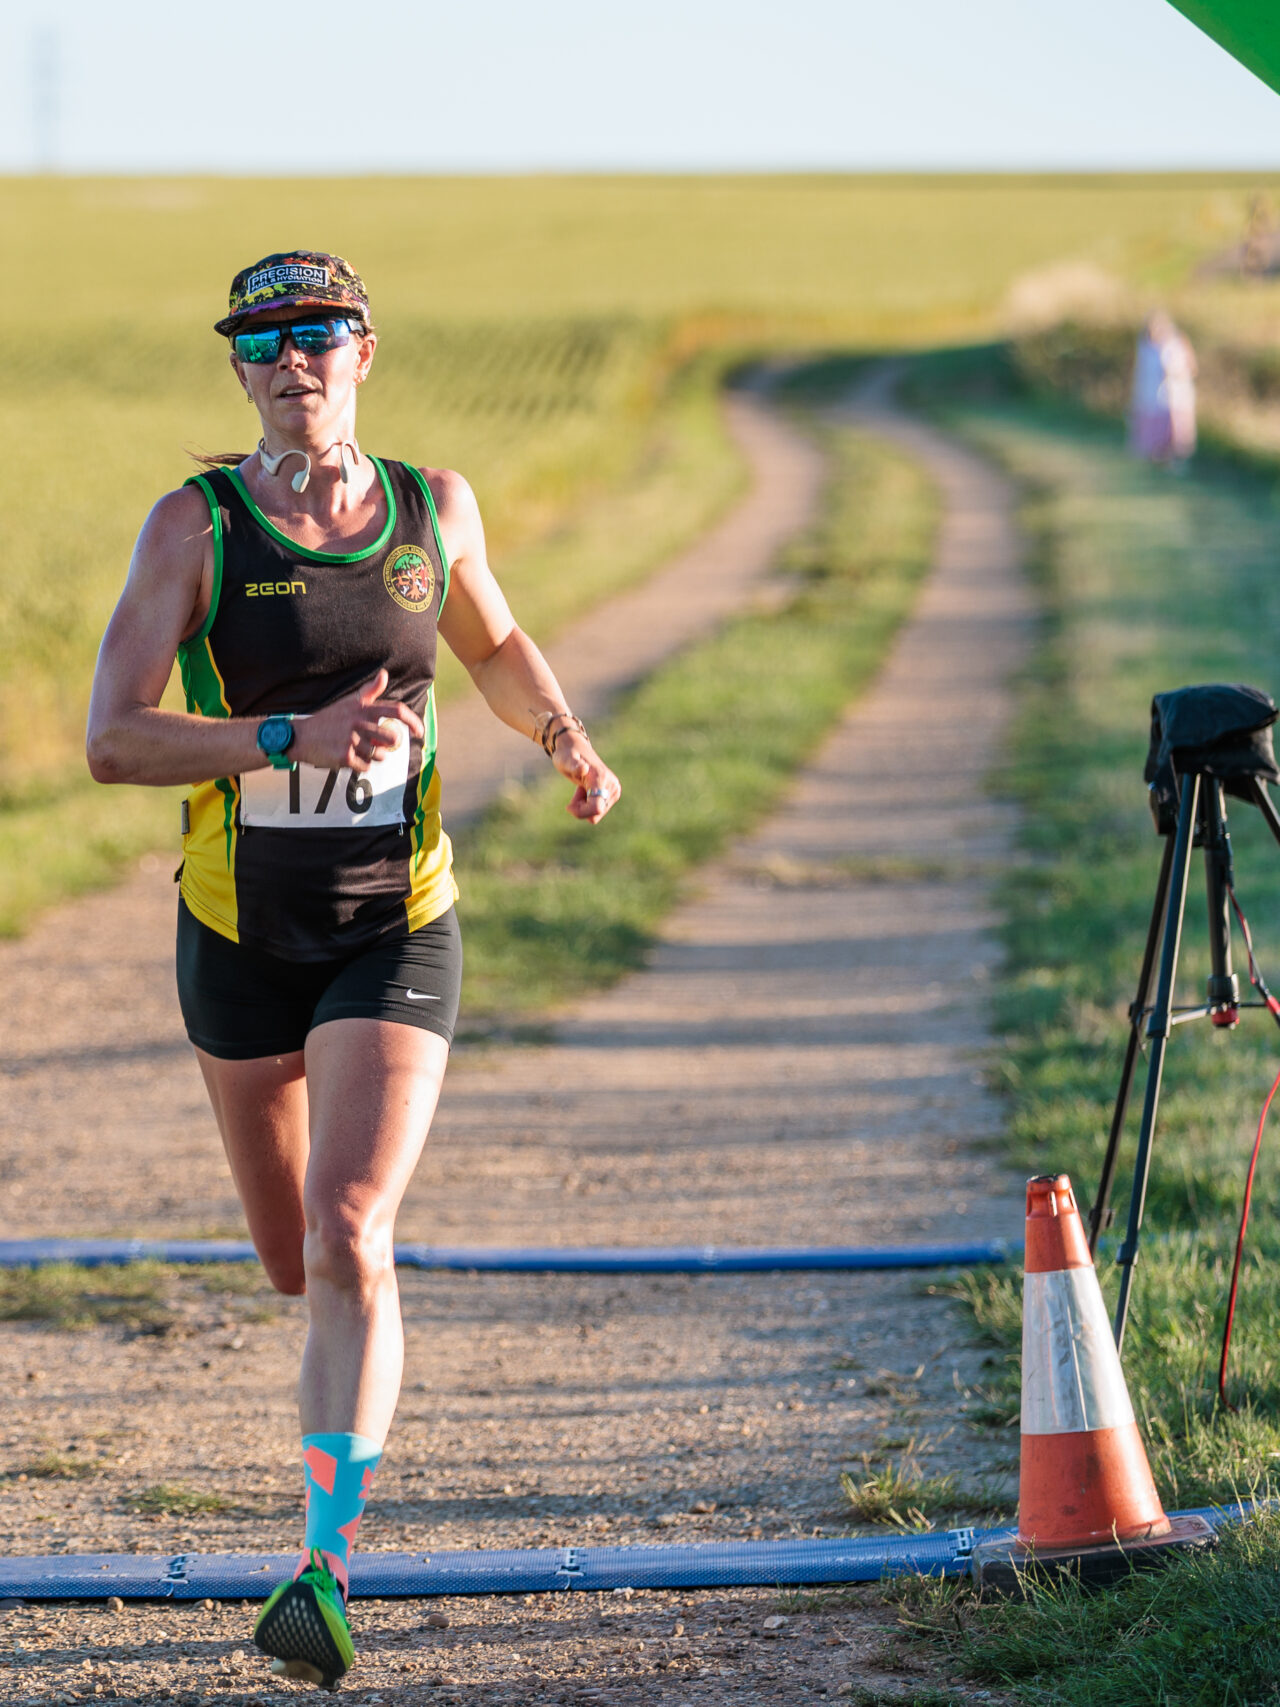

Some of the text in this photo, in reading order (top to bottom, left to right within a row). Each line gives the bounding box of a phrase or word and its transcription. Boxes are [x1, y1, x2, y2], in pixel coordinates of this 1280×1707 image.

[251, 281, 269, 291] FUEL
[277, 275, 323, 284] HYDRATION
[252, 267, 323, 286] PRECISION
[245, 581, 307, 597] ZEON
[288, 762, 373, 814] 176
